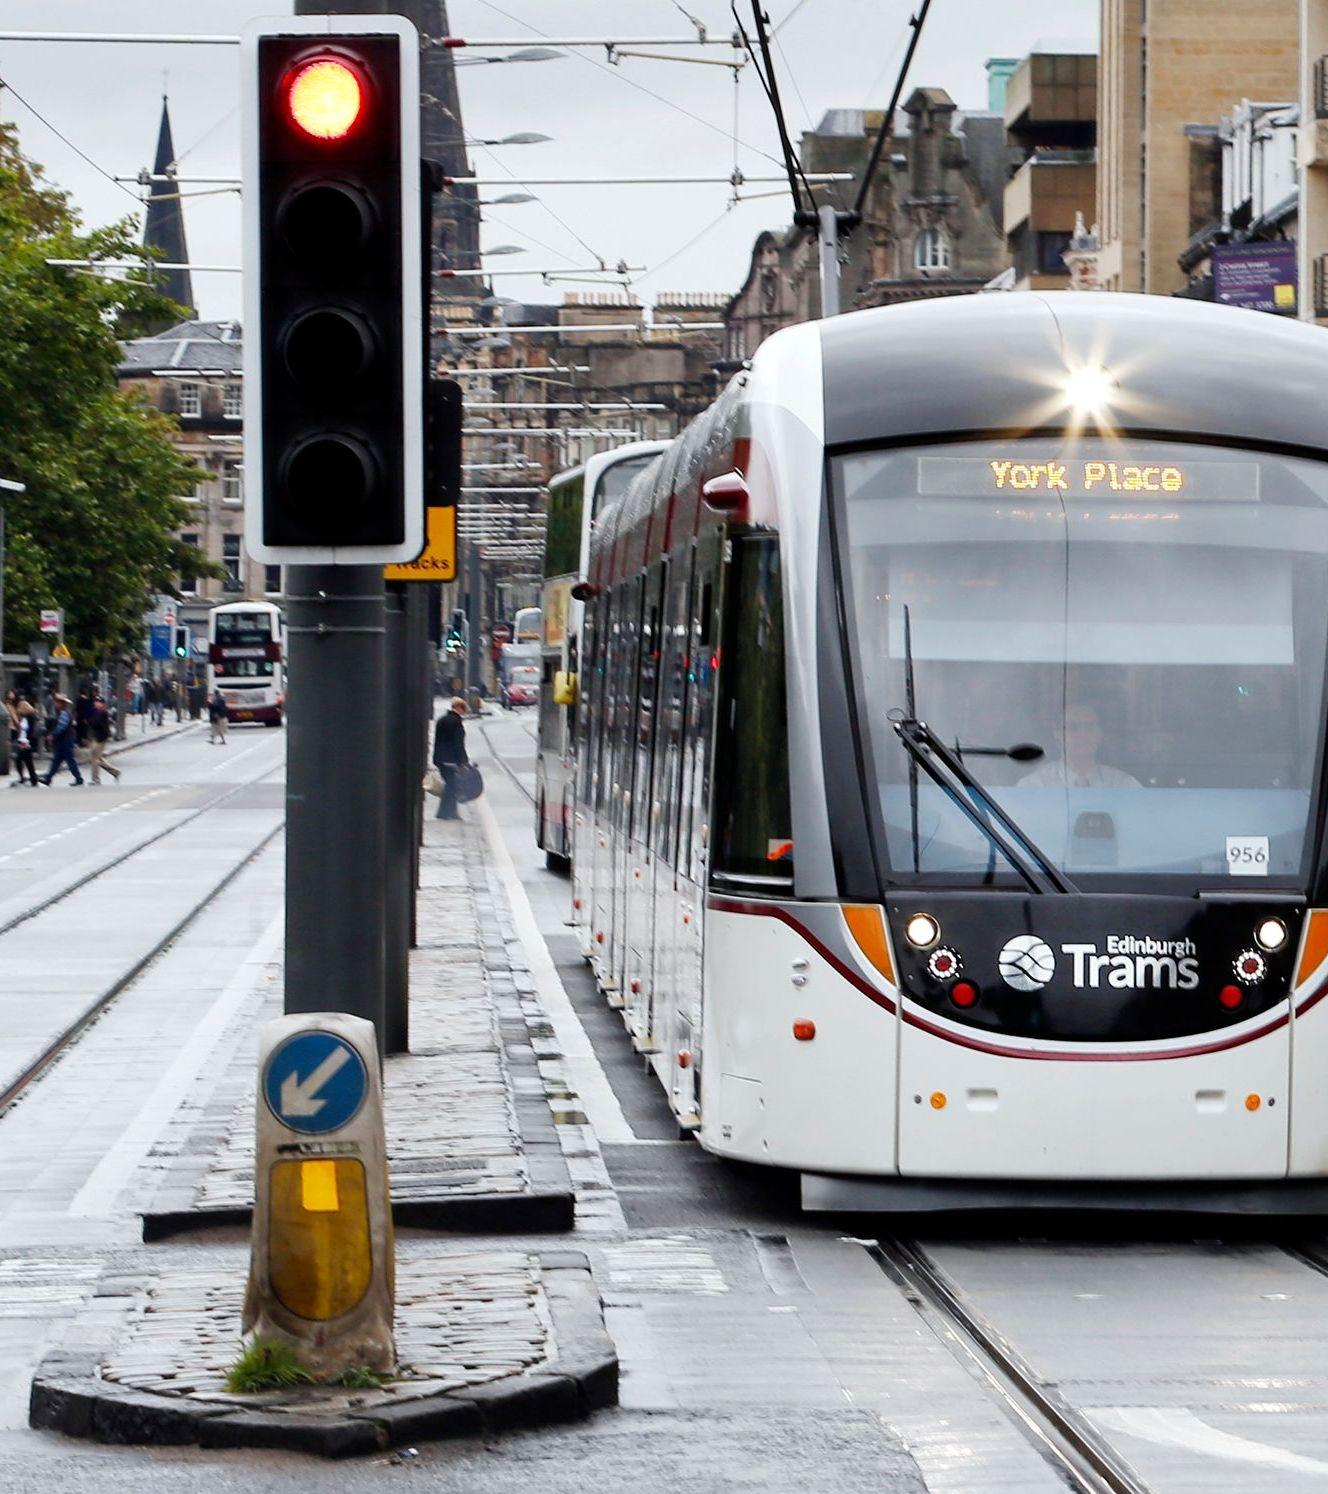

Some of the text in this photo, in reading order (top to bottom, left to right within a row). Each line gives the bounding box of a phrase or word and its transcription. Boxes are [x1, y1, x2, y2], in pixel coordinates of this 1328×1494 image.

[991, 460, 1183, 492] York Place
[1230, 847, 1265, 863] 956
[1107, 935, 1196, 959] Edinburgh
[1061, 943, 1200, 988] Trams
